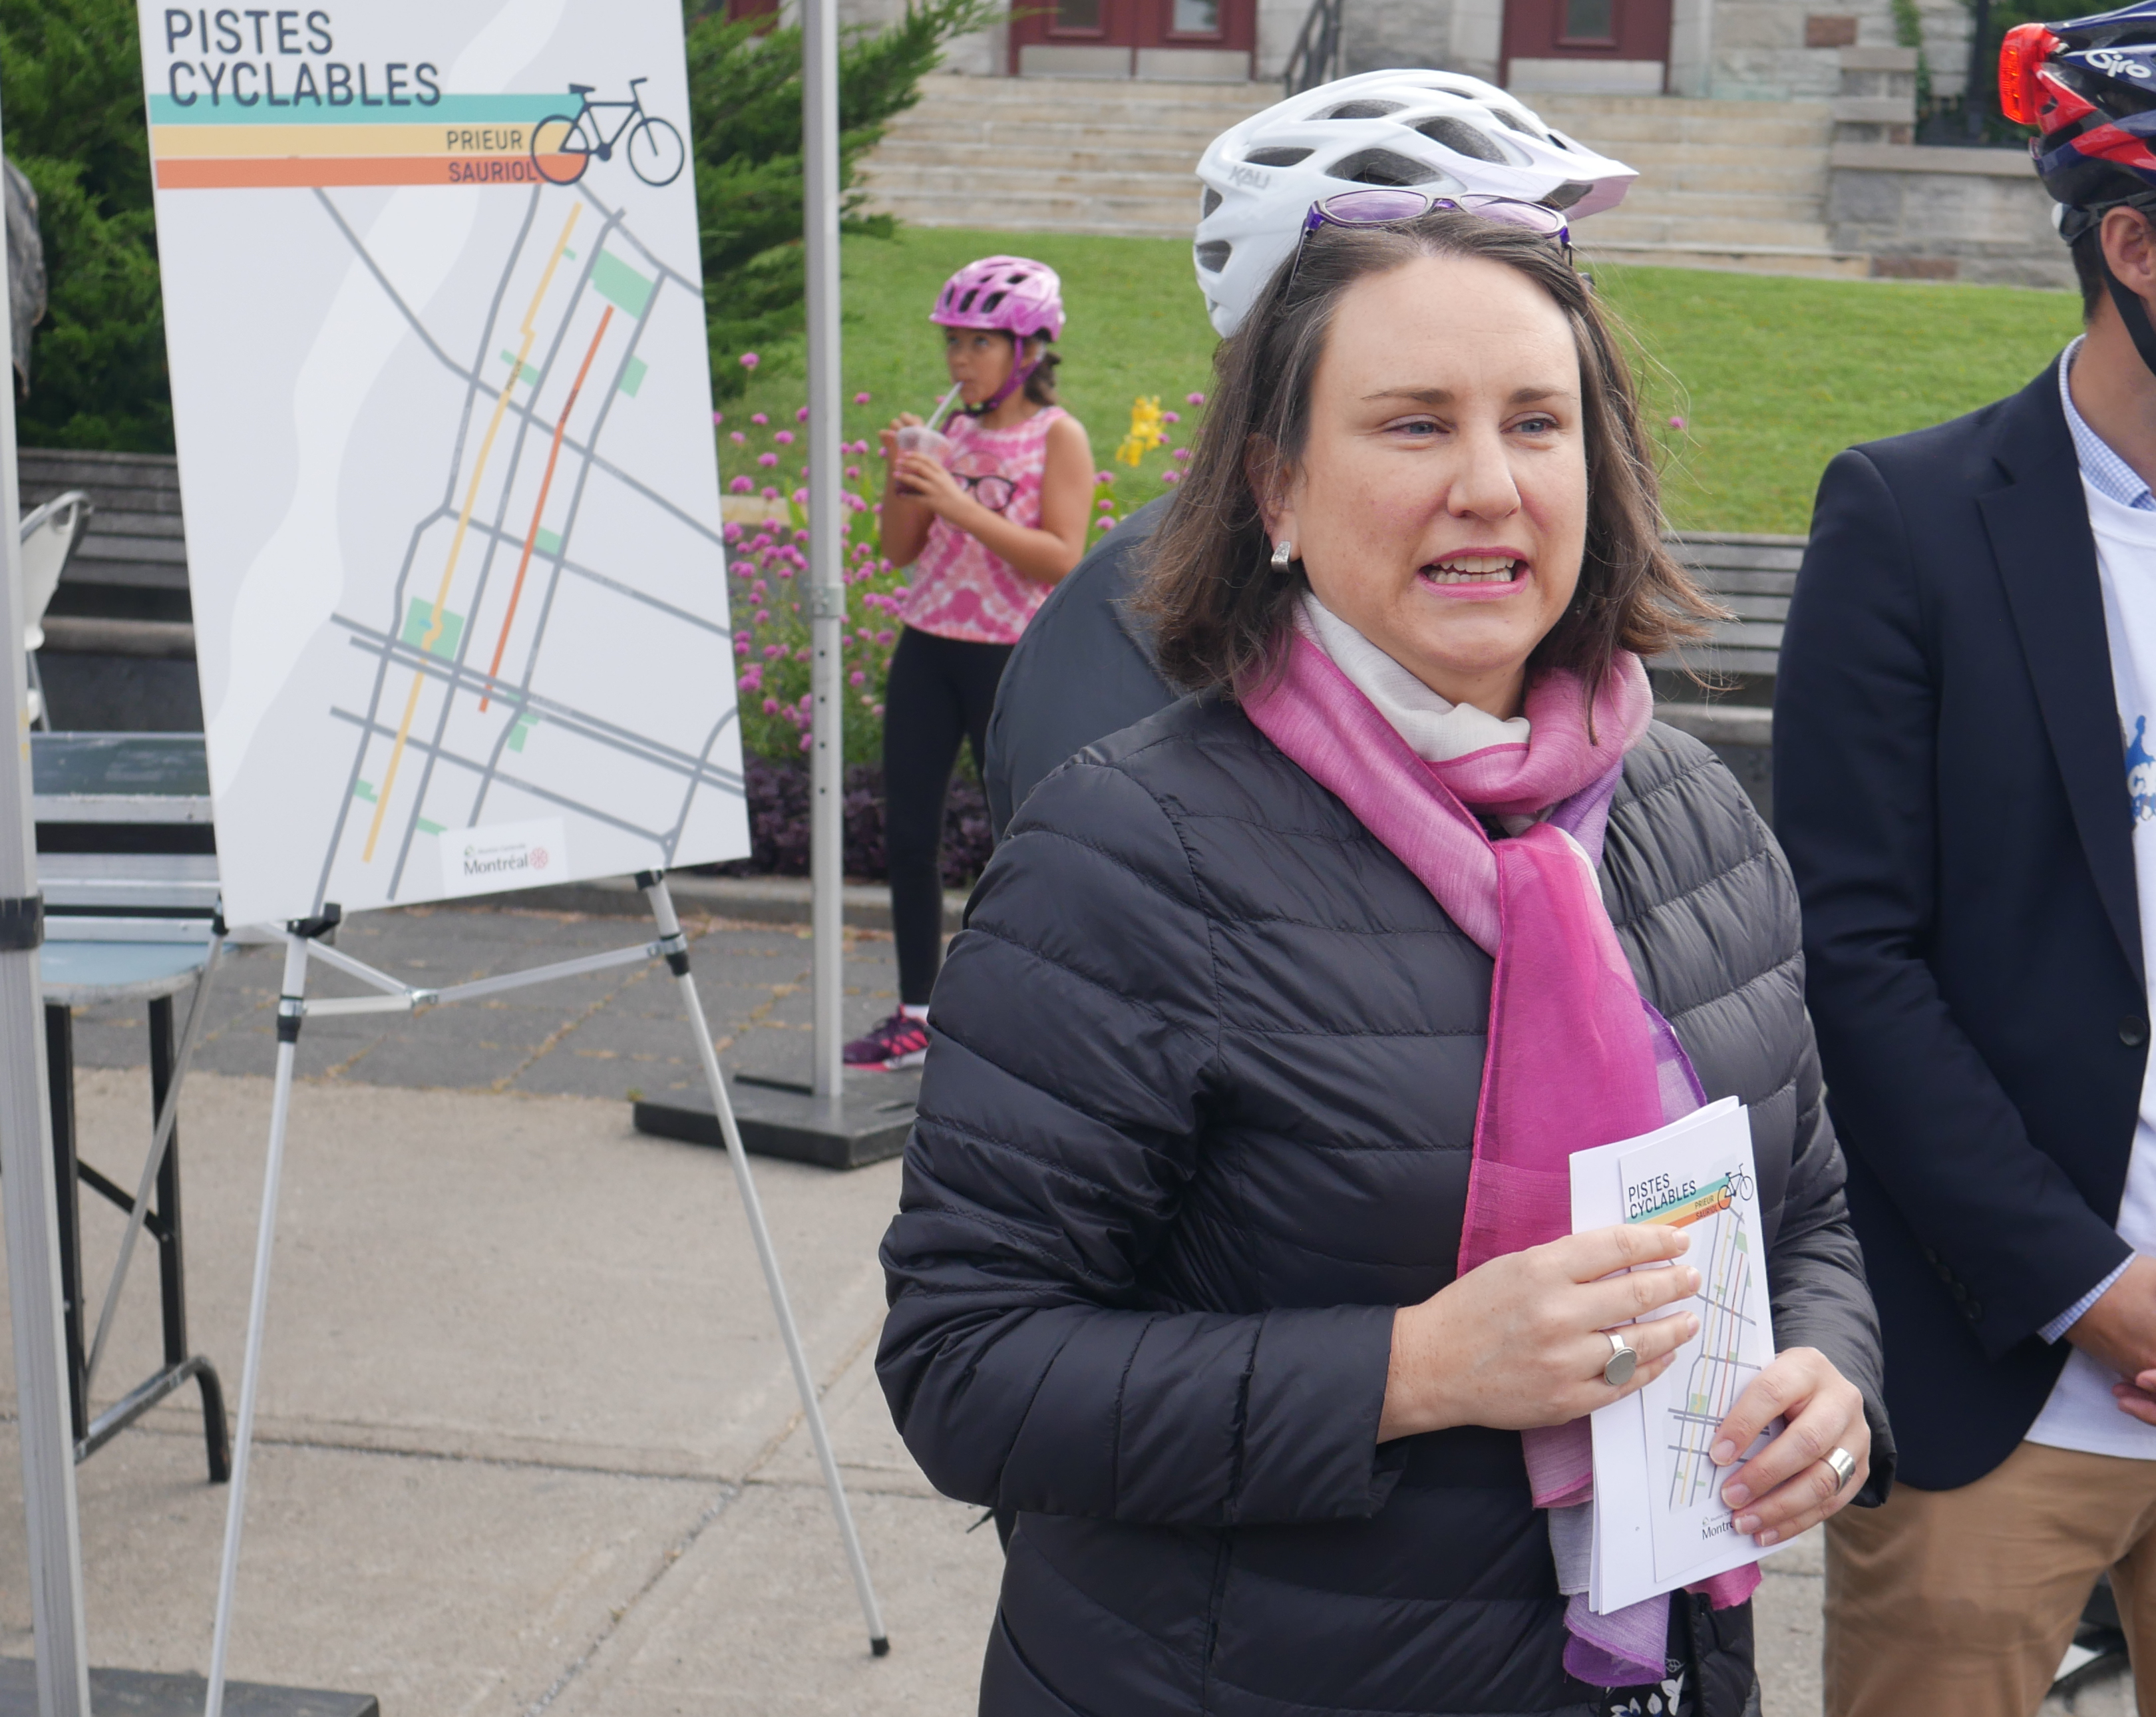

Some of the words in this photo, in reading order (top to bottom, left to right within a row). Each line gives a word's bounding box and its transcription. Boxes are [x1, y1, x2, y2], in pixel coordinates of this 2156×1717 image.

[165, 9, 333, 55] PISTES
[2085, 50, 2151, 78] Giro
[168, 62, 441, 107] CYCLABLES
[447, 130, 522, 150] PRIEUR
[449, 160, 537, 182] SAURIOL
[464, 854, 528, 874] Montréal
[1629, 1173, 1670, 1202] PISTES
[1630, 1181, 1696, 1219] CYCLABLES
[1695, 1195, 1714, 1209] PRIEUR
[1696, 1205, 1717, 1219] SAURIOL
[1702, 1522, 1733, 1540] Montr
